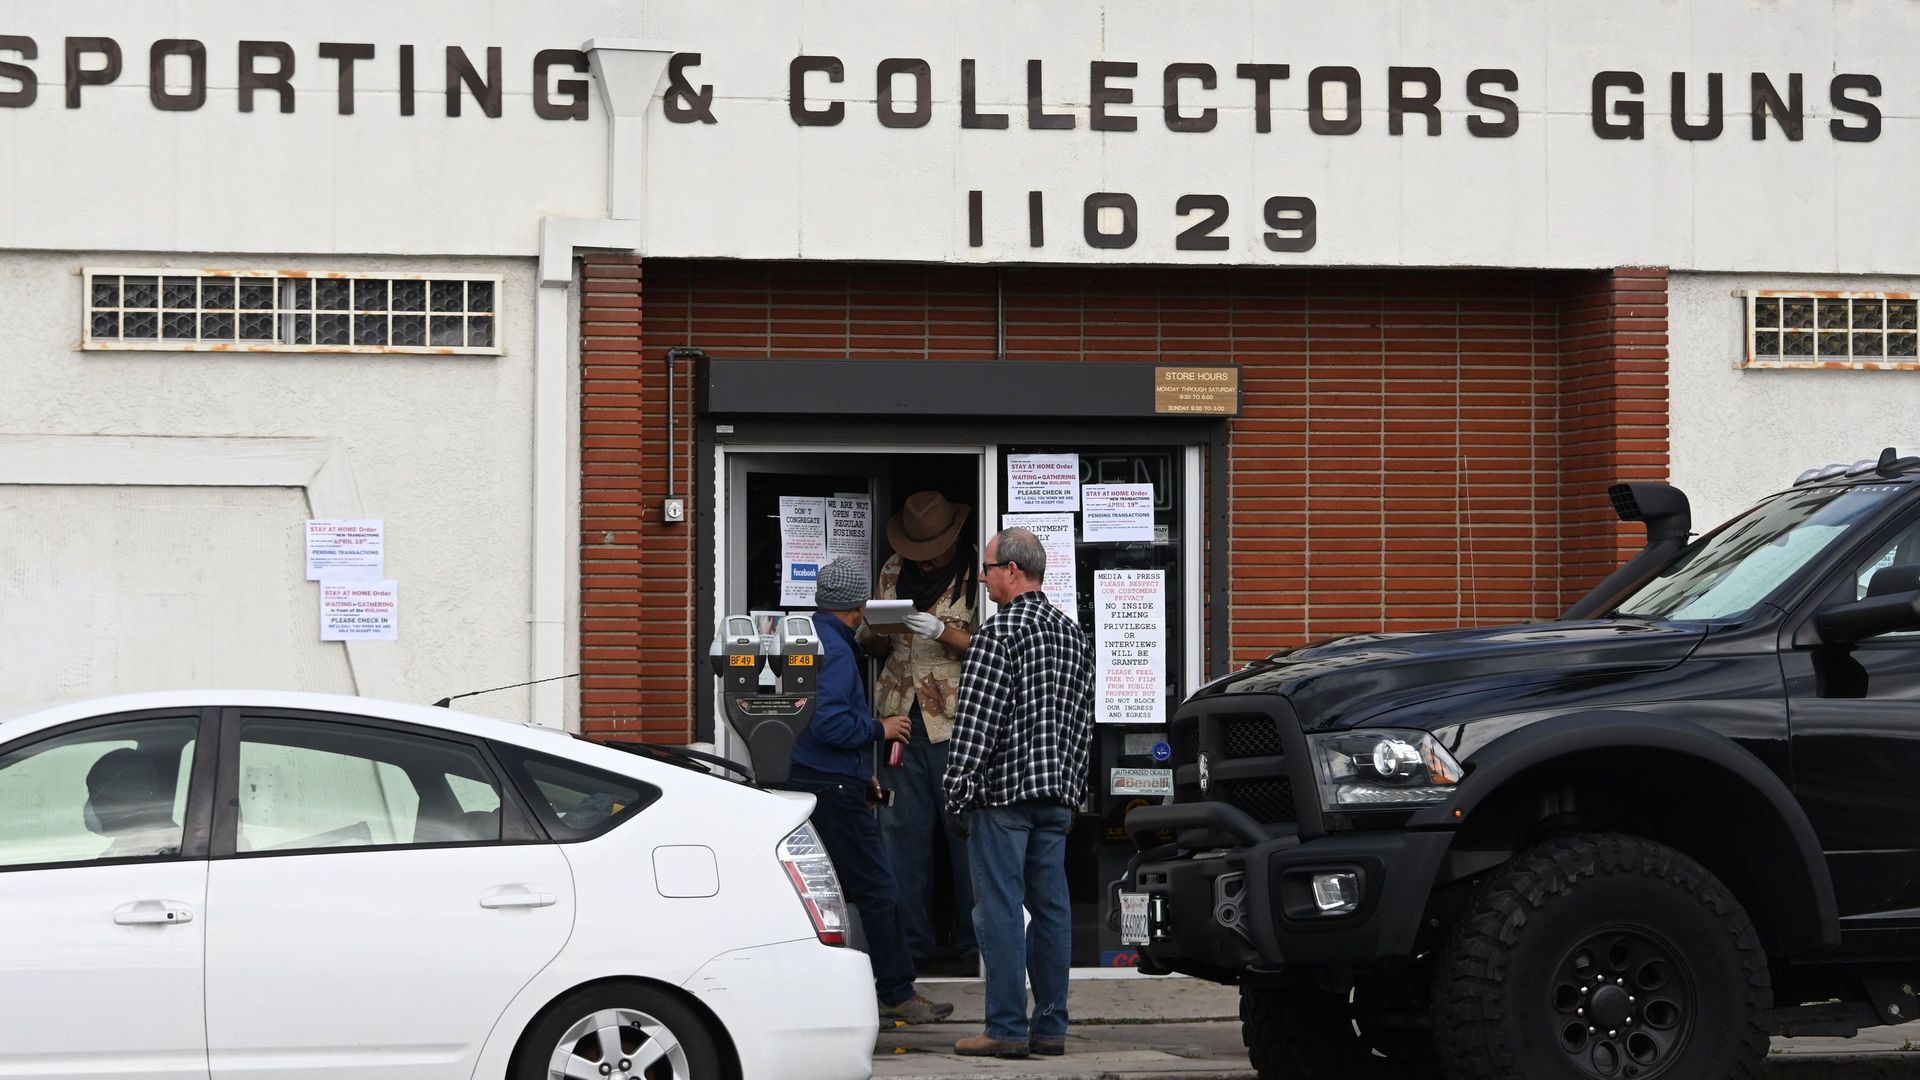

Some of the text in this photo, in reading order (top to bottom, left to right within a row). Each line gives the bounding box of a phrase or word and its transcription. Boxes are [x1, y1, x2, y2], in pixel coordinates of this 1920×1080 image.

[0, 35, 1882, 142] SPORTING & COLLECTORS GUNS
[969, 190, 1317, 252] 11029
[1165, 372, 1195, 380] STORE
[840, 501, 853, 509] ARE
[856, 502, 869, 510] NOT
[832, 510, 865, 519] OPEN FOR
[835, 520, 864, 528] REGULAR
[833, 529, 865, 537] BUSINESS
[793, 568, 816, 576] facebook
[1125, 777, 1168, 788] Benelli
